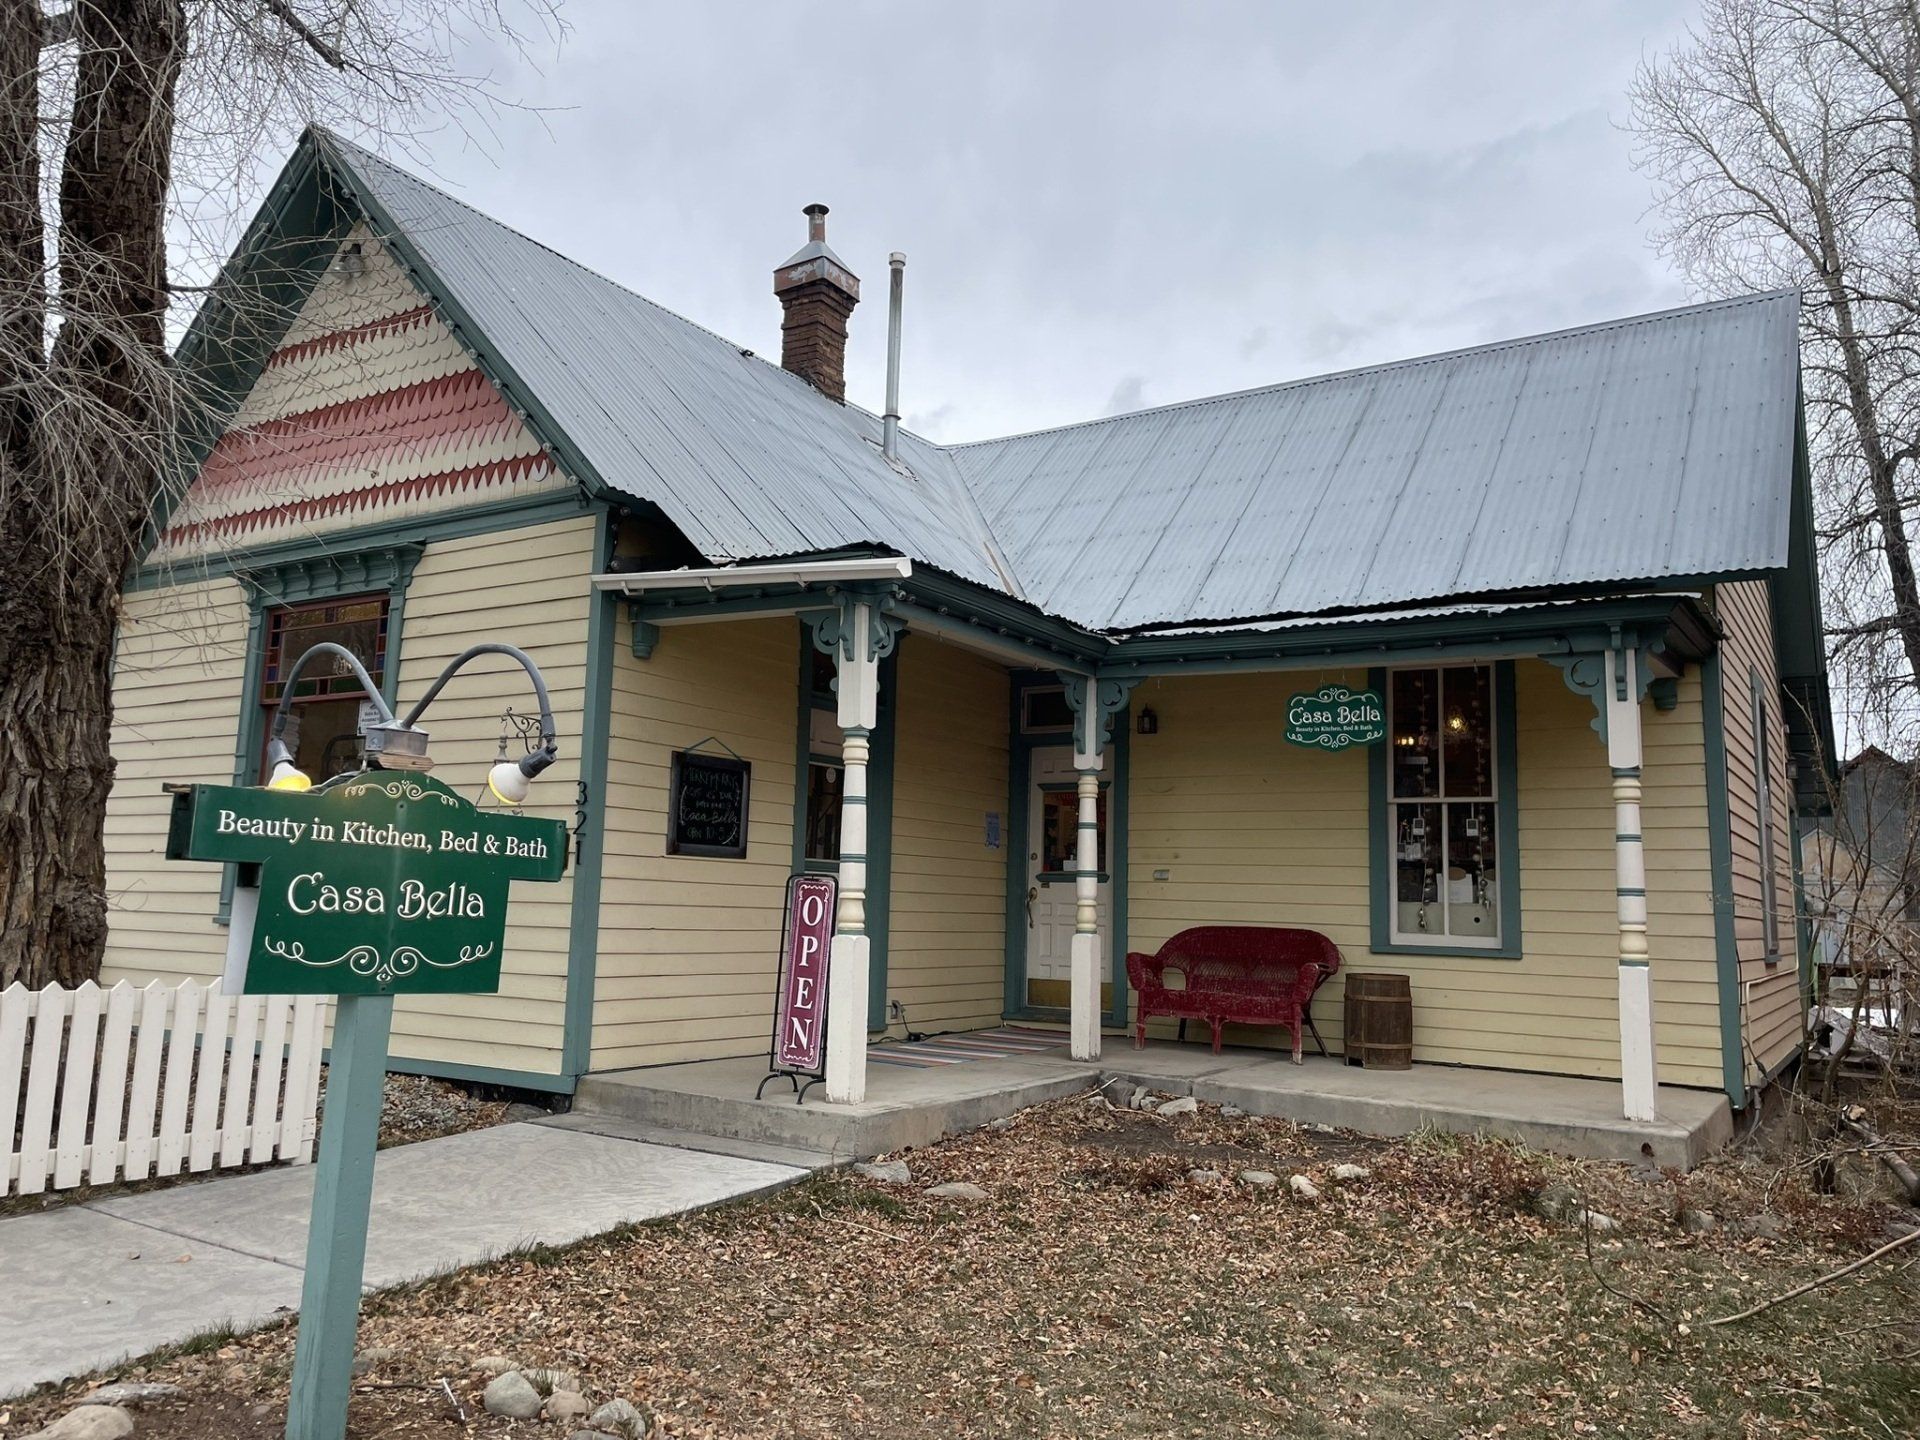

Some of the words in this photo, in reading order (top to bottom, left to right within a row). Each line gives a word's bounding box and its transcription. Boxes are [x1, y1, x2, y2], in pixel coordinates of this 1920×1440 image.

[1289, 706, 1332, 725] Casa
[1337, 705, 1381, 724] Bella
[217, 810, 306, 844] Beauty
[311, 817, 335, 842] in
[341, 821, 432, 854] Kitchen,
[439, 830, 478, 852] Bed
[483, 834, 500, 854] &
[504, 836, 548, 858] Bath
[287, 871, 385, 914] Casa
[397, 879, 485, 919] Bella
[789, 895, 824, 1050] OPEN
